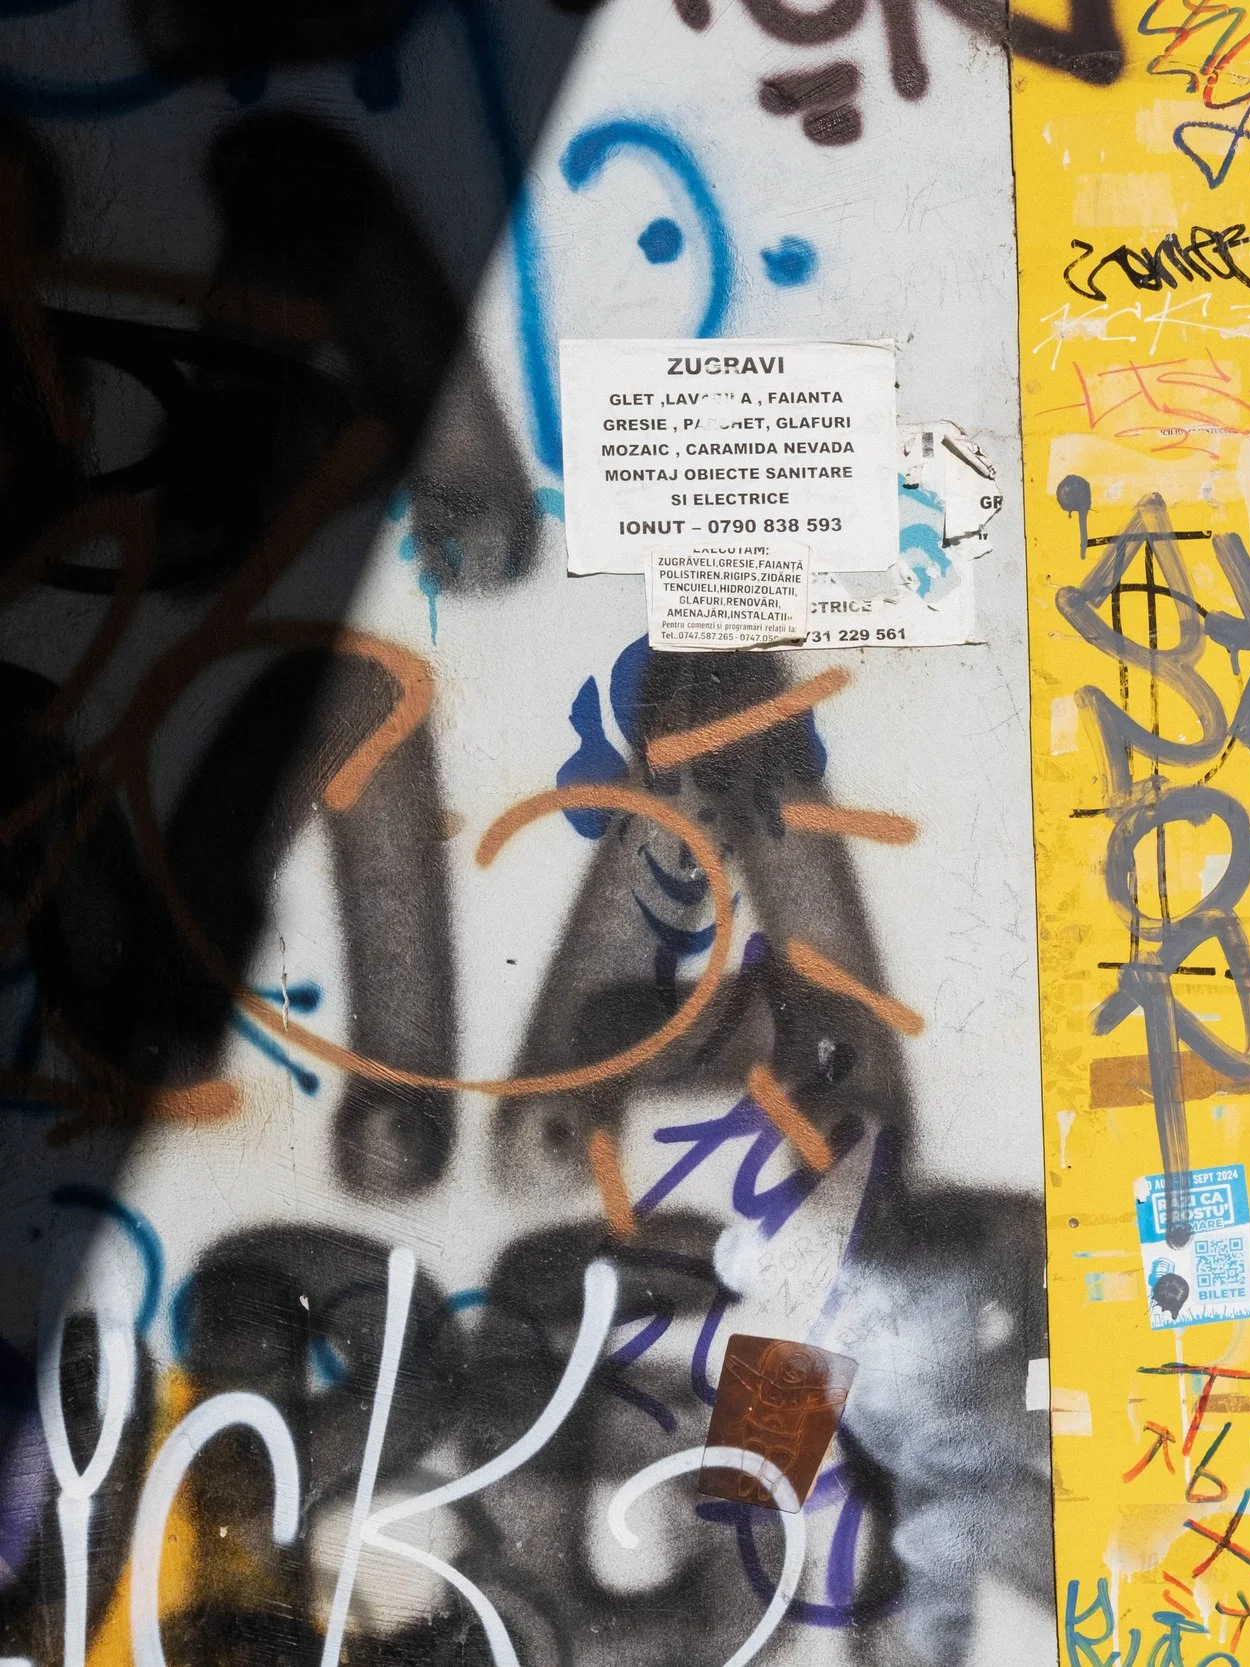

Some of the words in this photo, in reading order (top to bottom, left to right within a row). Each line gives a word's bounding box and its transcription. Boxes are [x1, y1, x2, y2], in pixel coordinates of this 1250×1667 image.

[667, 356, 785, 375] ZUGRAVI
[609, 393, 654, 406] GLET
[768, 391, 843, 404] FAIANTA
[603, 418, 667, 431] GRESIE
[776, 416, 851, 430] GLAFURI
[601, 443, 670, 457] MOZAIC
[685, 442, 778, 456] CARAMIDA
[783, 441, 855, 455] NEVADA
[605, 468, 678, 482] MONTAJ
[684, 467, 760, 481] OBIECTE
[765, 465, 853, 480] SANITARE
[671, 493, 687, 506] SI
[693, 492, 789, 506] ELECTRICE
[619, 520, 685, 535] IONUT
[708, 519, 757, 534] 0790
[763, 518, 800, 533] 838
[806, 517, 842, 532] 593
[662, 620, 685, 629] Pentru
[687, 622, 716, 631] comenzi
[838, 629, 870, 642] 229
[876, 627, 906, 641] 561
[1192, 1172, 1214, 1184] SEPT
[1216, 1169, 1238, 1182] 2024
[1200, 1191, 1224, 1205] CA
[1199, 1287, 1247, 1301] BILETE
